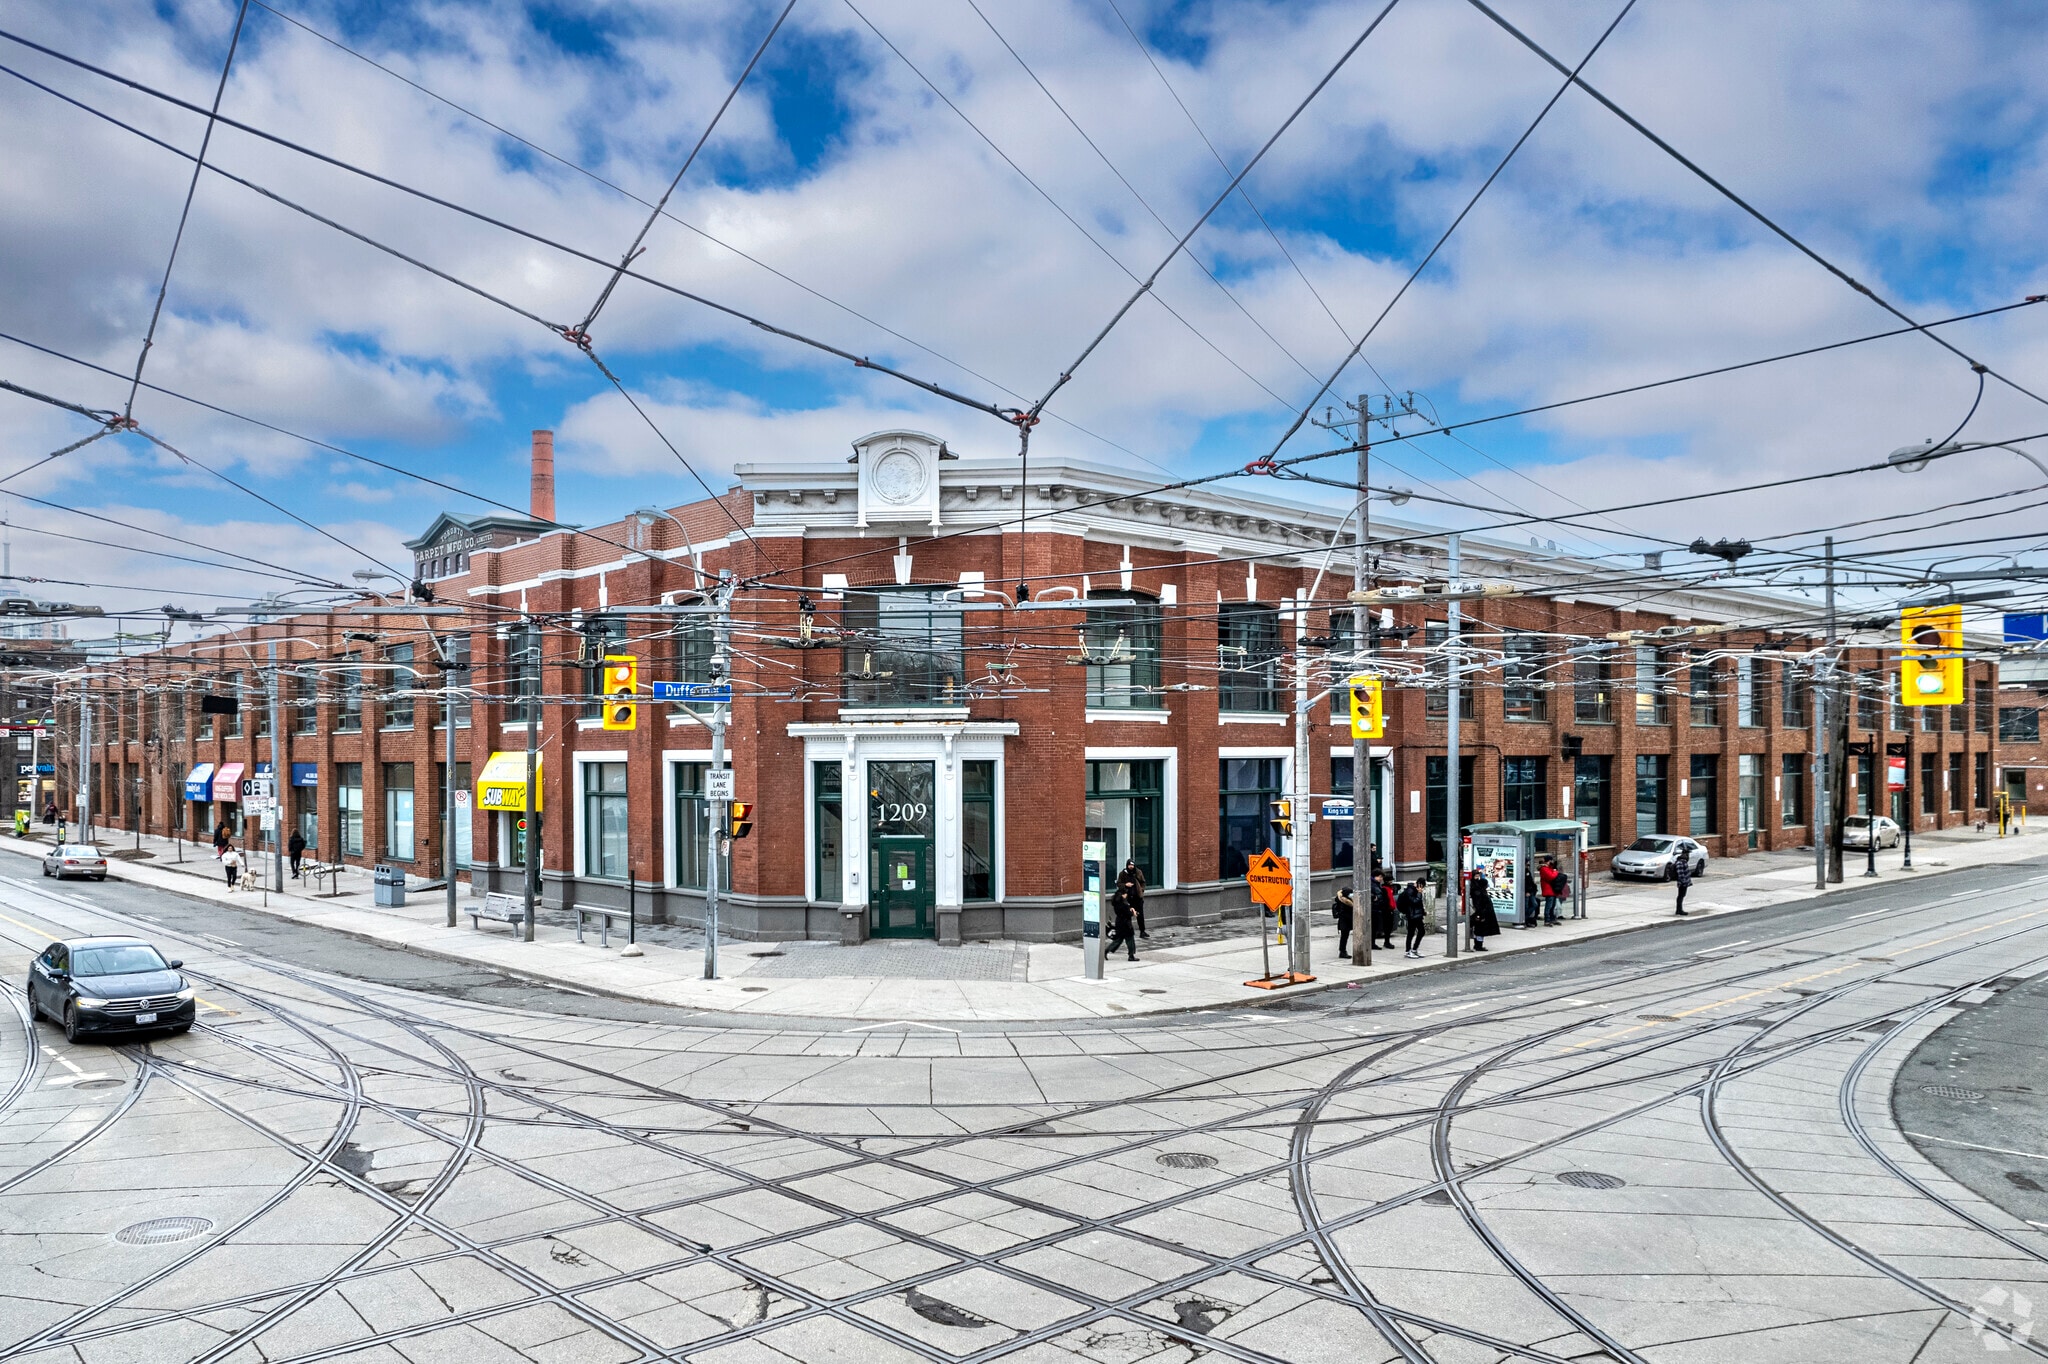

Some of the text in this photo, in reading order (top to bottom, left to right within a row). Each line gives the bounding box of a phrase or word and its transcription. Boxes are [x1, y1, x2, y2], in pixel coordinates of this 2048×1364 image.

[441, 527, 464, 542] TORONTO
[415, 544, 444, 562] CARPET
[446, 540, 465, 554] MFG.
[710, 772, 731, 780] TRANSIT
[712, 781, 727, 789] LANE
[483, 787, 526, 808] SUBWAY
[877, 803, 927, 822] 1209
[1327, 808, 1339, 816] King
[1249, 874, 1291, 886] CONSTRUCTIO
